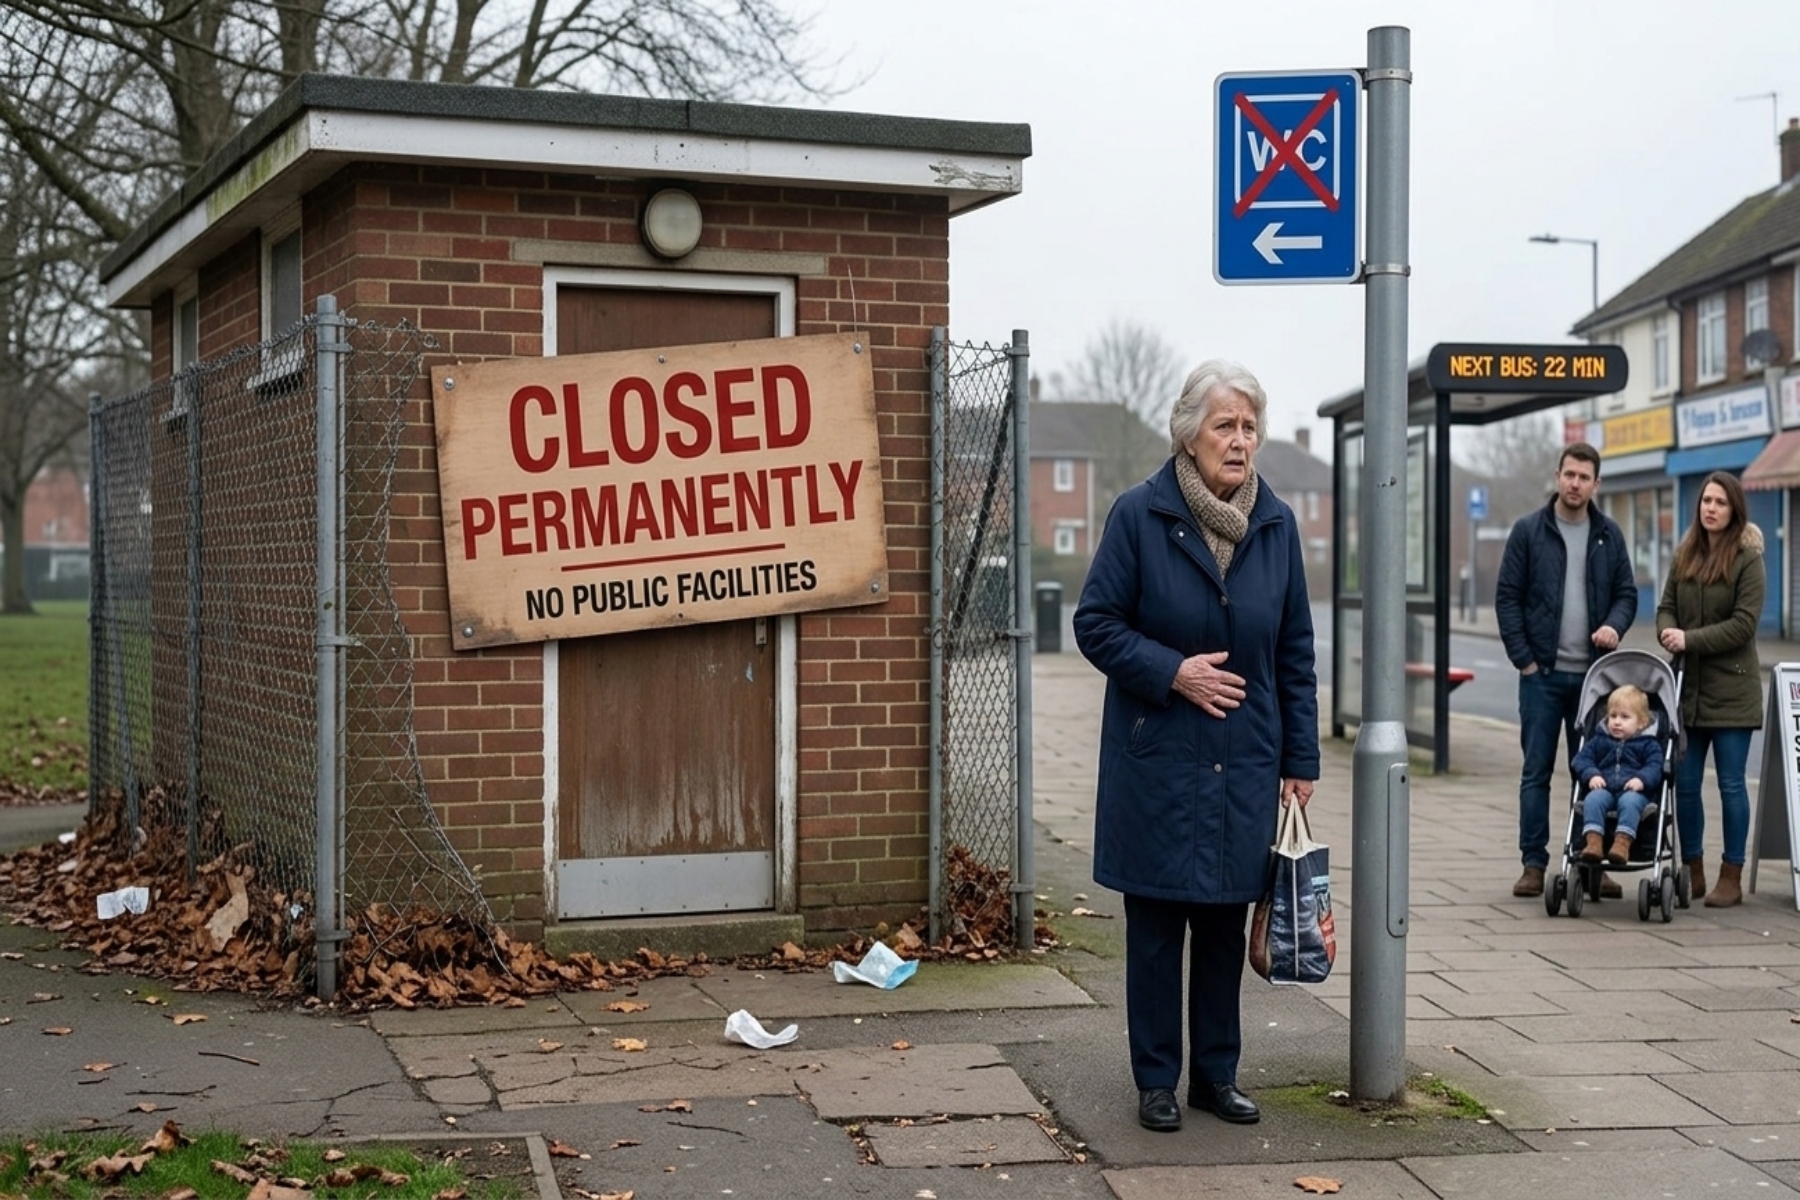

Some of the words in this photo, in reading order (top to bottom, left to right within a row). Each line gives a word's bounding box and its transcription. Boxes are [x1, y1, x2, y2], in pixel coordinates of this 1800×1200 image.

[1450, 355, 1493, 377] NEXT
[1500, 355, 1538, 378] BUS:
[1544, 356, 1566, 378] 22
[1573, 356, 1605, 378] MIN
[509, 364, 811, 473] CLOSED
[461, 460, 863, 560] PERMANENTLY
[526, 587, 564, 620] NO
[573, 575, 668, 615] PUBLIC
[677, 560, 817, 604] FACILITIES
